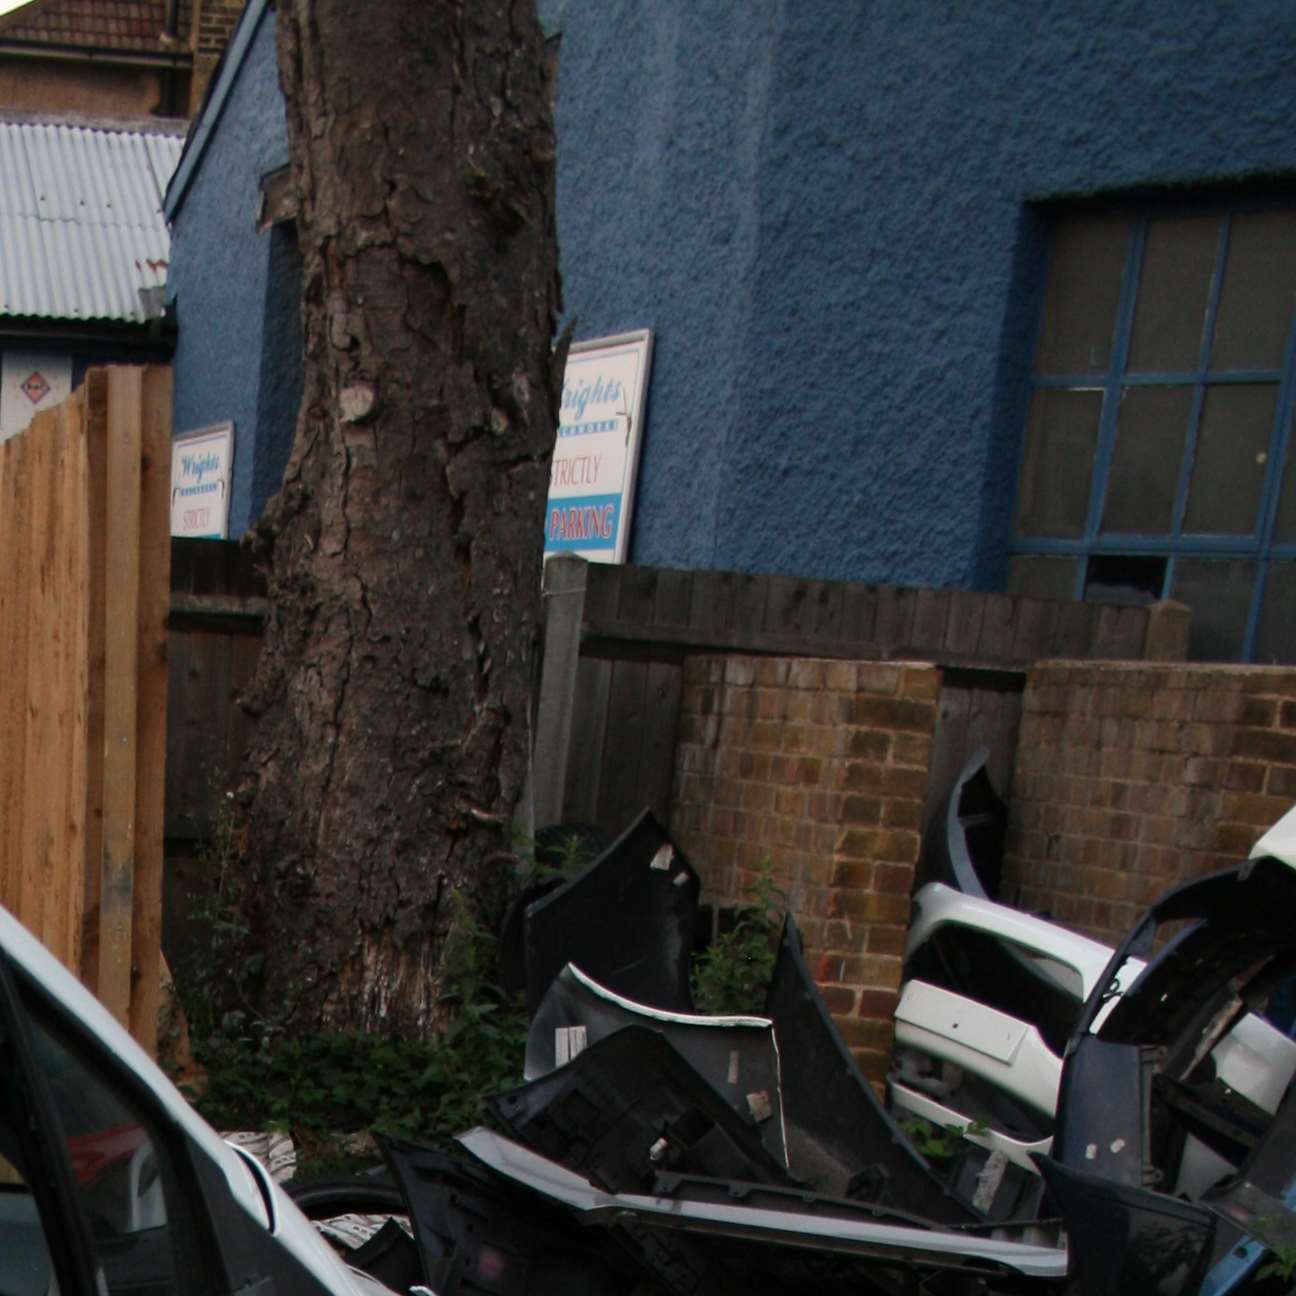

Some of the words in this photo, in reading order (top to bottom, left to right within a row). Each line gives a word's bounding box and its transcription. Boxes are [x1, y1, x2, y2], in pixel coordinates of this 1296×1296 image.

[562, 375, 622, 421] rights
[552, 455, 603, 488] TRICTLY
[549, 503, 615, 542] PARKING
